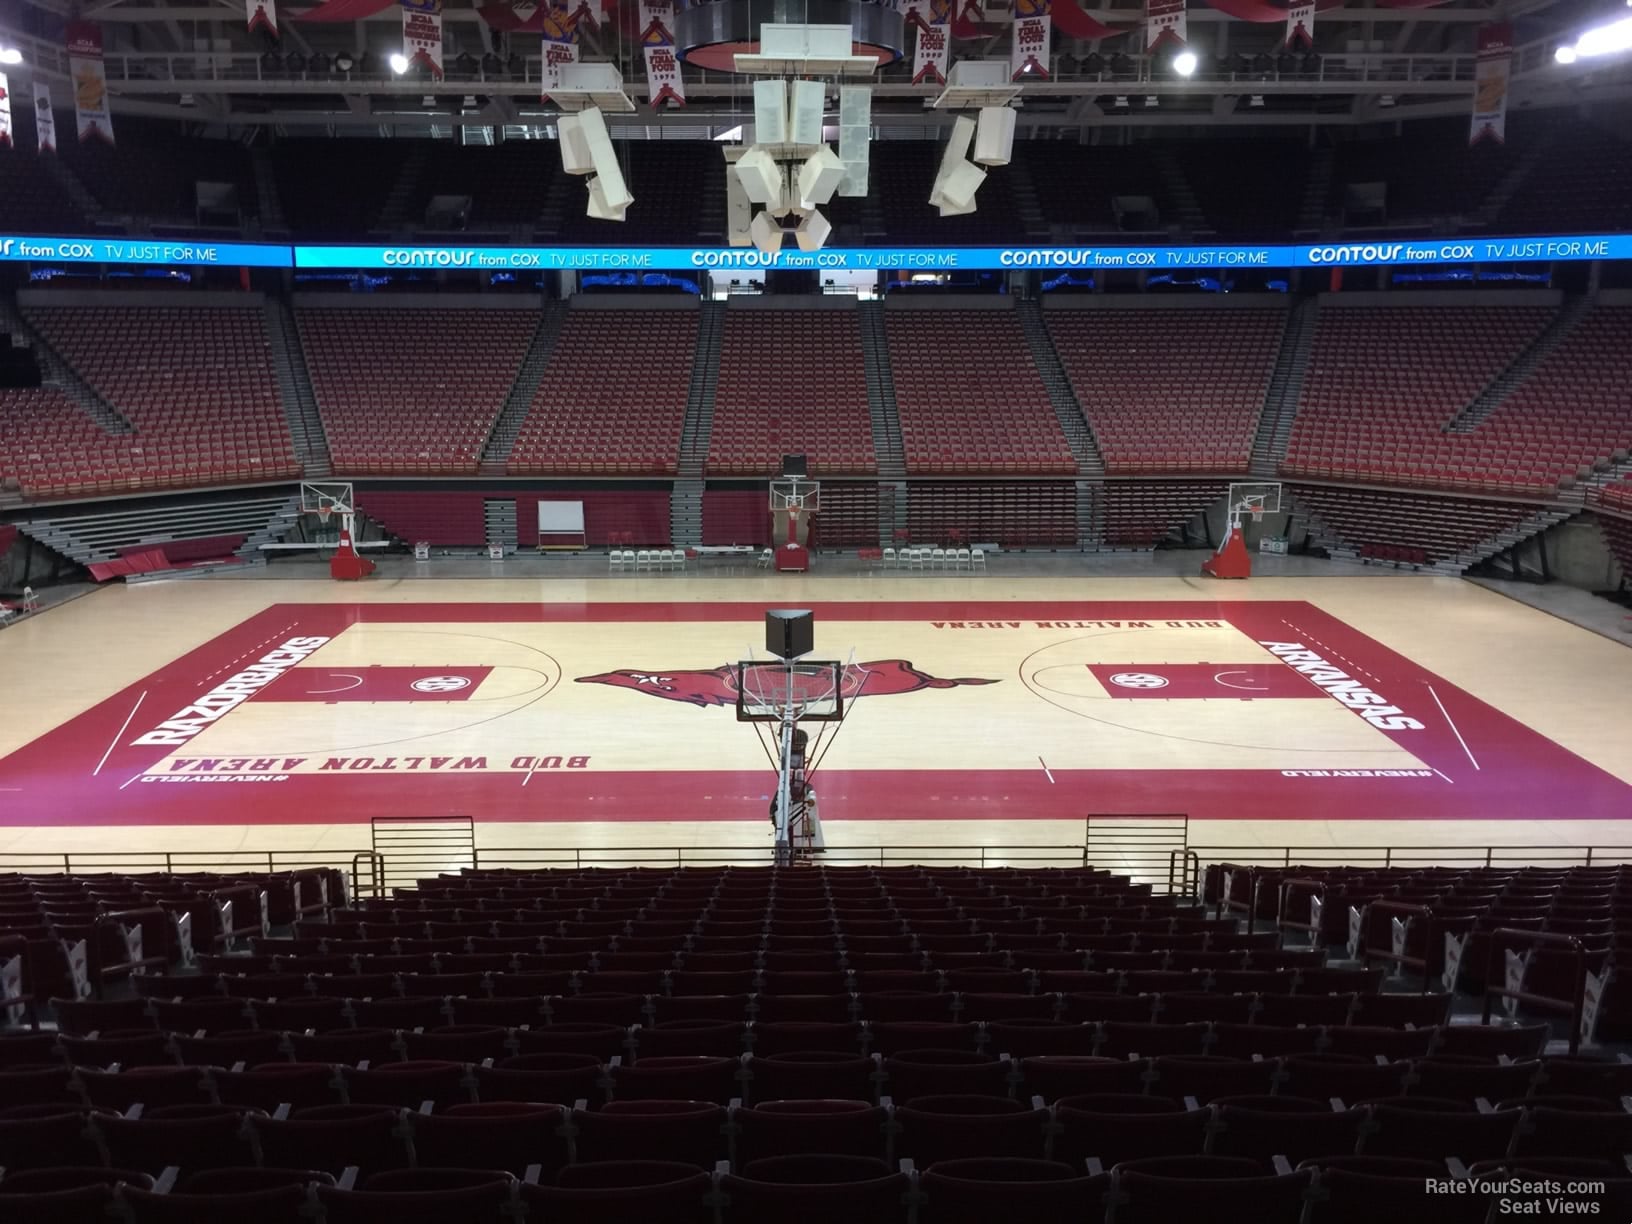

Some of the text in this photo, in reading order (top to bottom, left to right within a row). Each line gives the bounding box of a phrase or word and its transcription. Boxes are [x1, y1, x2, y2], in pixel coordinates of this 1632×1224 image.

[1018, 26, 1046, 36] FINAL
[920, 33, 945, 42] FINAL
[1019, 35, 1044, 45] FOUR
[920, 41, 945, 50] FOUR
[546, 50, 573, 60] FINAL
[649, 55, 675, 64] FINAL
[652, 63, 675, 72] FOUR
[20, 244, 54, 257] from
[58, 244, 94, 258] COX
[105, 245, 124, 258] TV
[127, 246, 160, 260] JUST
[164, 246, 192, 260] FOR
[197, 248, 217, 261] ME
[1406, 247, 1437, 260] from
[1441, 245, 1474, 258] COX
[1486, 244, 1504, 257] TV
[1507, 243, 1543, 256] JUST
[1547, 243, 1579, 255] FOR
[1585, 241, 1609, 254] ME
[479, 254, 507, 265] from
[511, 254, 540, 266] COX
[551, 255, 566, 265] TV
[569, 254, 598, 266] JUST
[602, 255, 628, 265] FOR
[632, 255, 651, 266] ME
[786, 254, 814, 266] from
[817, 254, 847, 266] COX
[857, 254, 873, 265] TV
[875, 254, 904, 266] JUST
[908, 254, 934, 265] FOR
[938, 254, 958, 265] ME
[1095, 254, 1122, 265] from
[1126, 253, 1156, 264] COX
[1167, 252, 1182, 263] TV
[1184, 252, 1215, 264] JUST
[1218, 252, 1245, 263] FOR
[1249, 252, 1268, 263] ME
[1036, 621, 1154, 629] WALTON
[1259, 640, 1426, 730] ARKANSAS
[129, 636, 330, 746] RAZORBACKS
[169, 756, 591, 771] BUD WALTON ARENA
[1281, 769, 1433, 777] #NEVERYIELD
